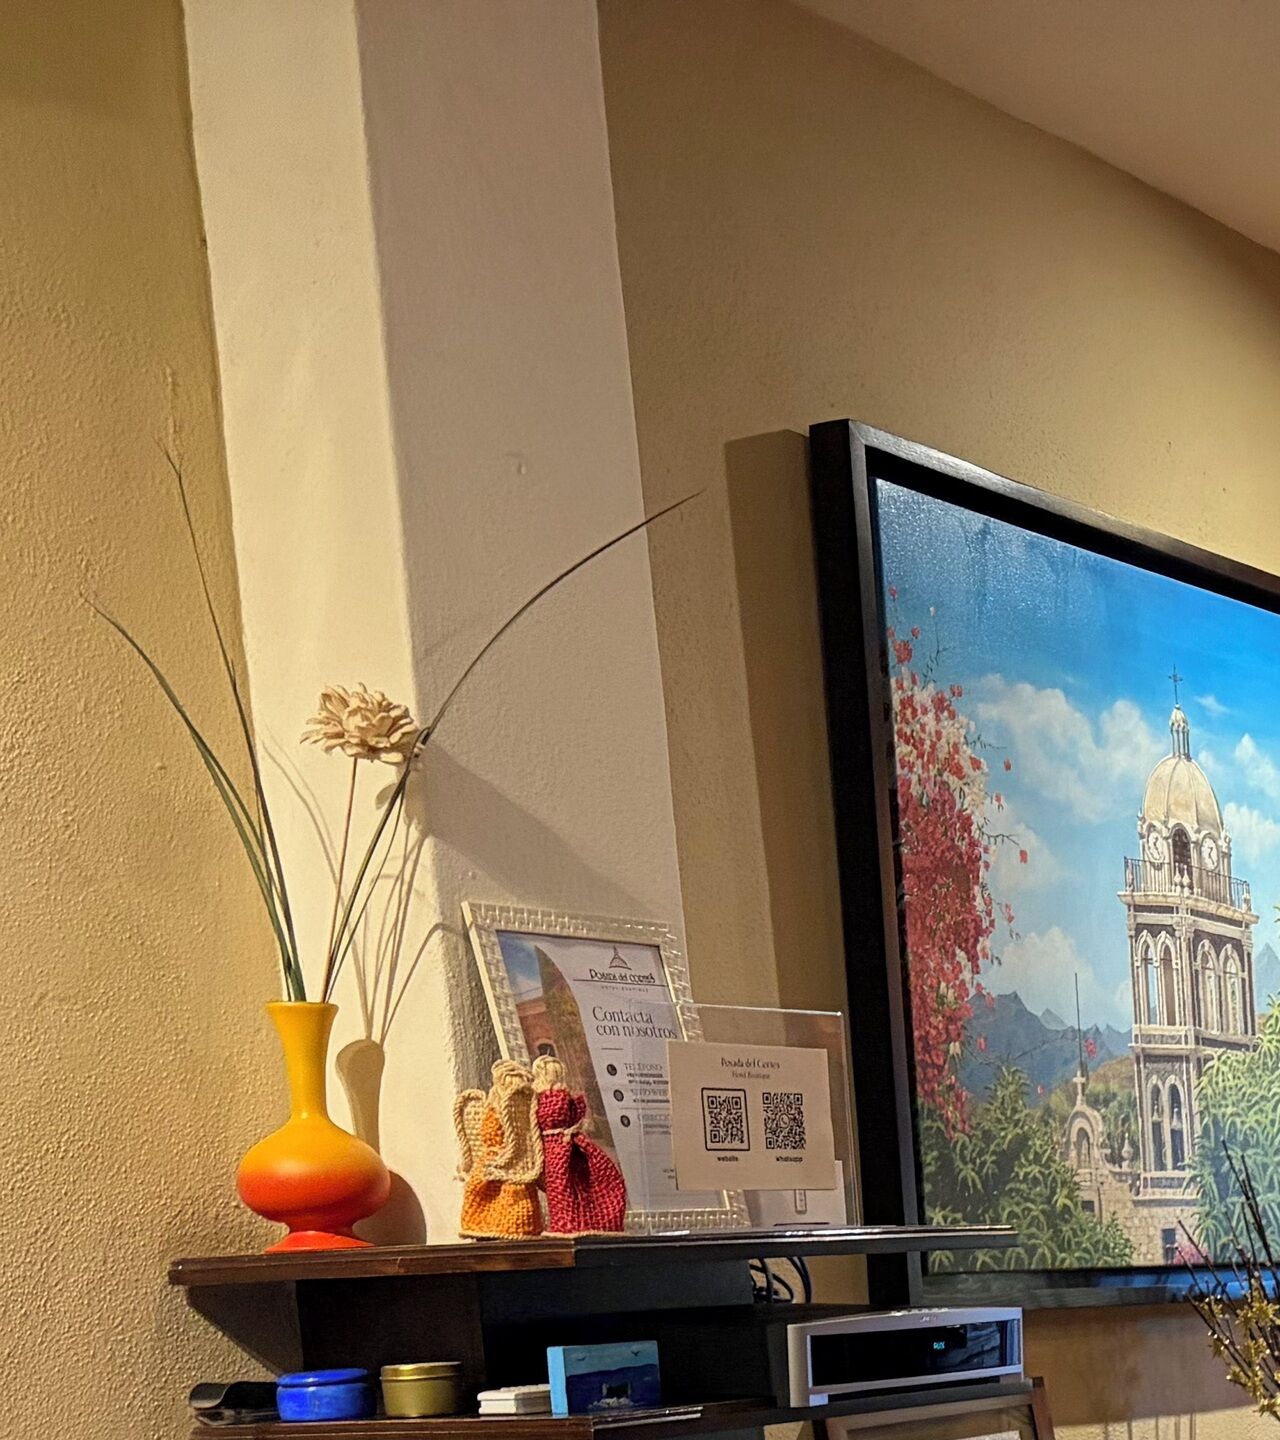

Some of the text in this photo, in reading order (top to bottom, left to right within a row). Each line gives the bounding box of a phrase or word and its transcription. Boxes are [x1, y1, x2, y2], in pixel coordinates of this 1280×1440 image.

[592, 1006, 654, 1024] Contacta
[596, 1024, 678, 1039] con nosotros
